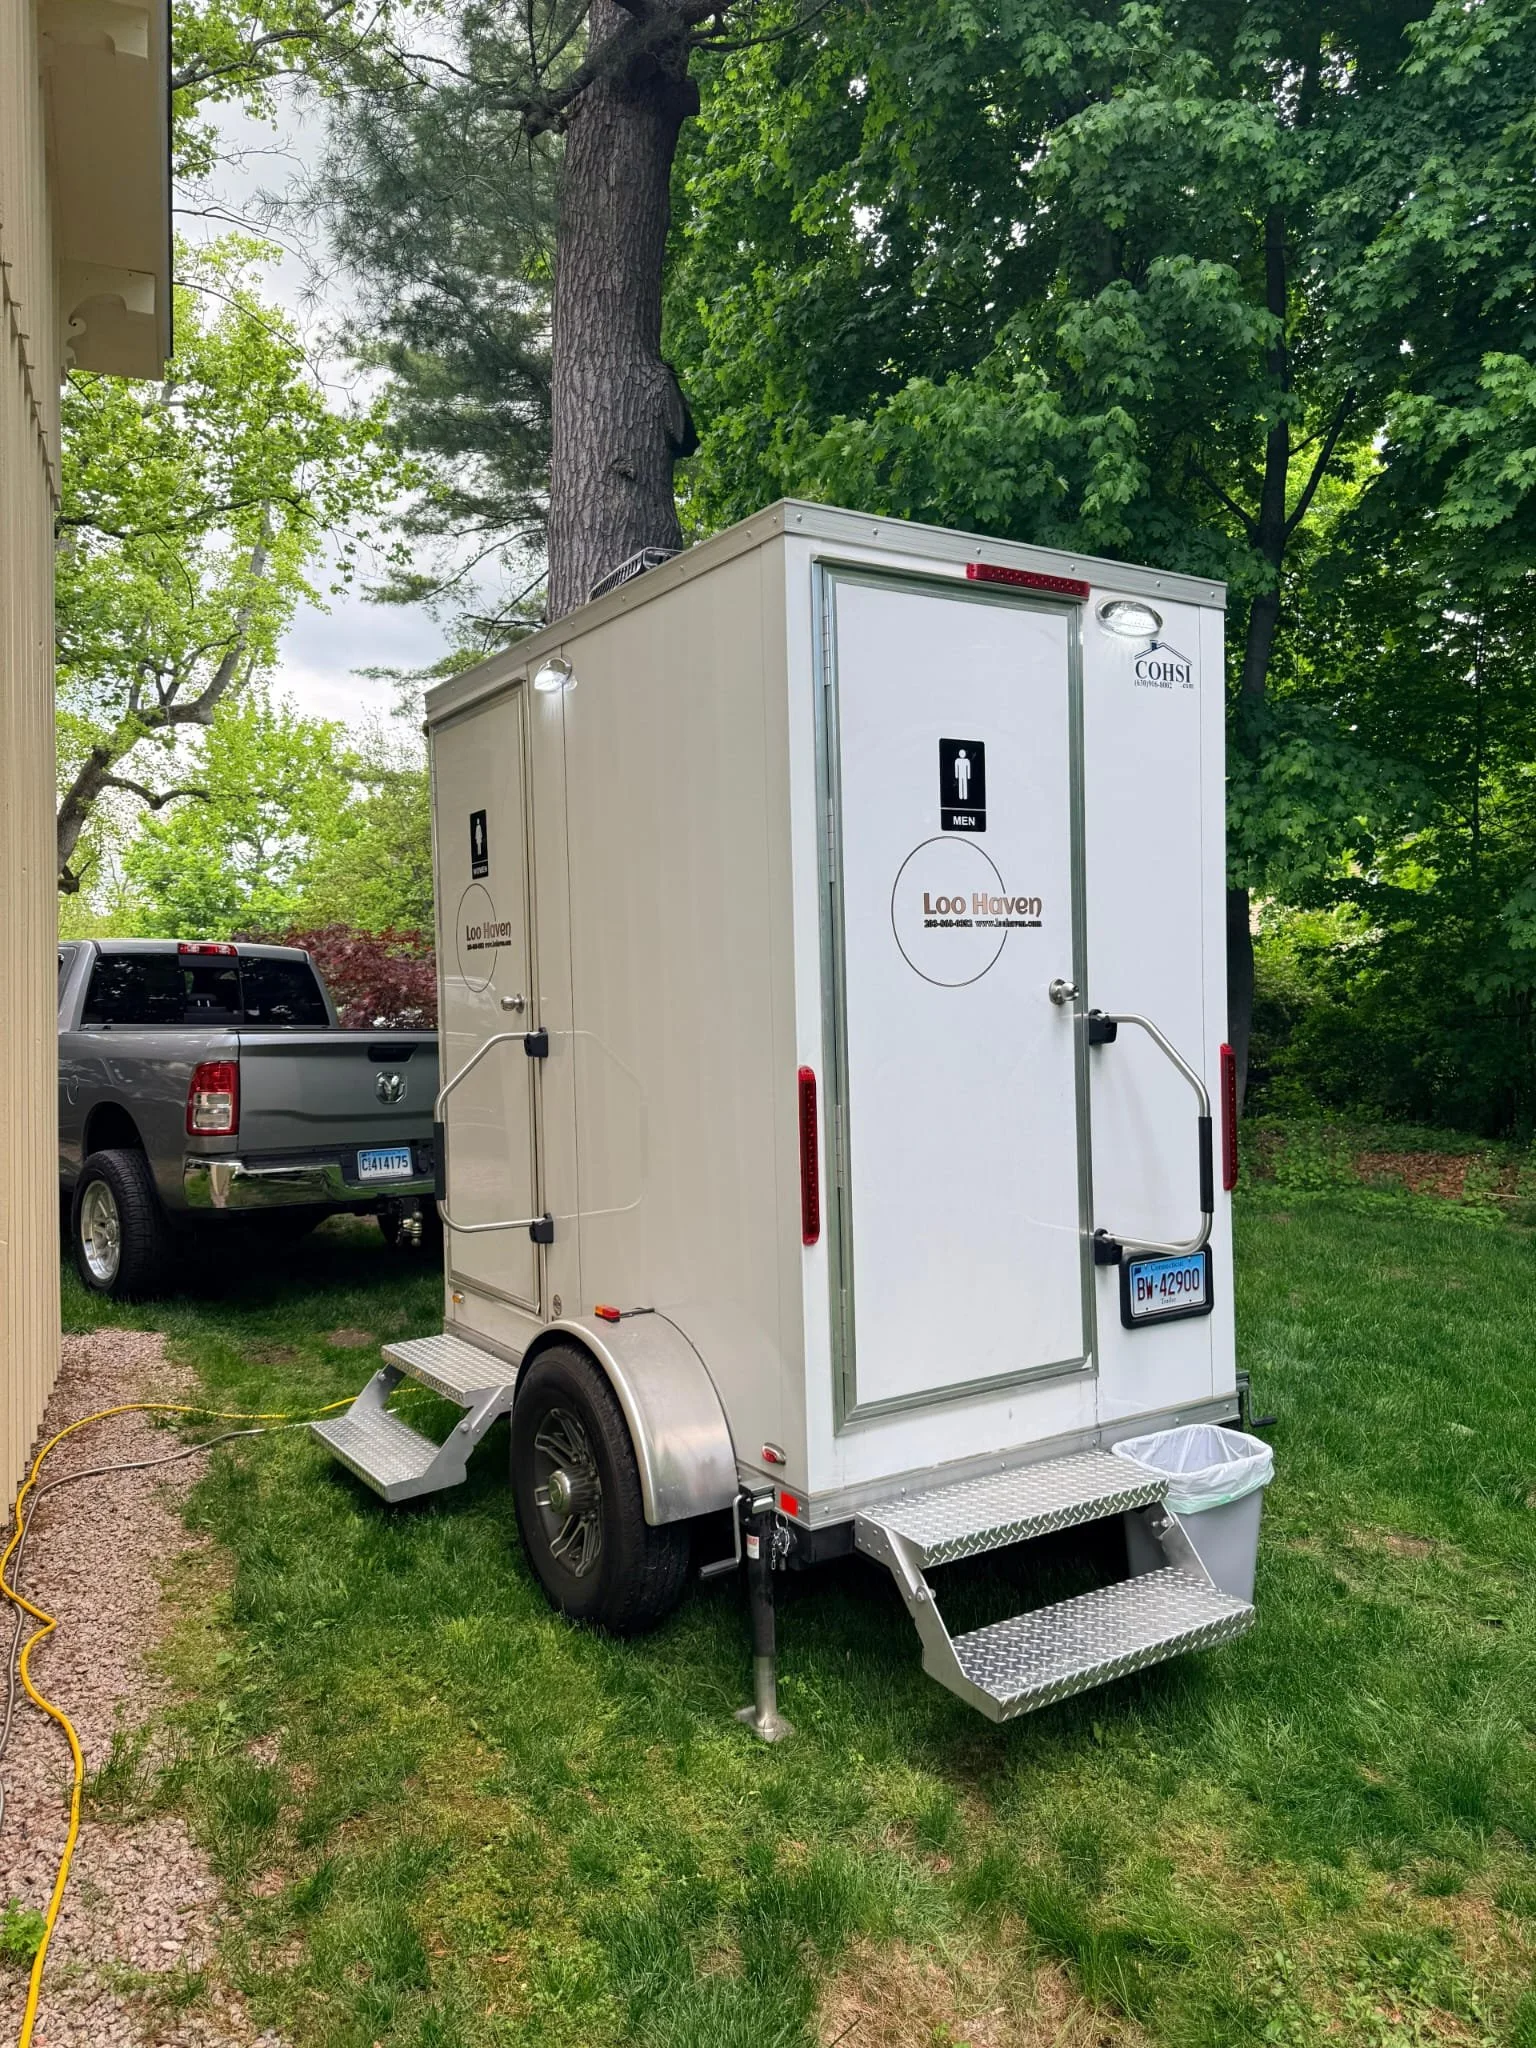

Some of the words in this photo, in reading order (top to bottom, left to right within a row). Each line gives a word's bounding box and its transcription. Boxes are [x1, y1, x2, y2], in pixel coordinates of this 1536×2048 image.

[1135, 660, 1191, 683] COHSI
[953, 815, 976, 827] MEN
[923, 892, 967, 915] Loo
[972, 892, 1042, 917] Haven
[466, 925, 482, 941] Loo
[483, 921, 512, 939] Haven
